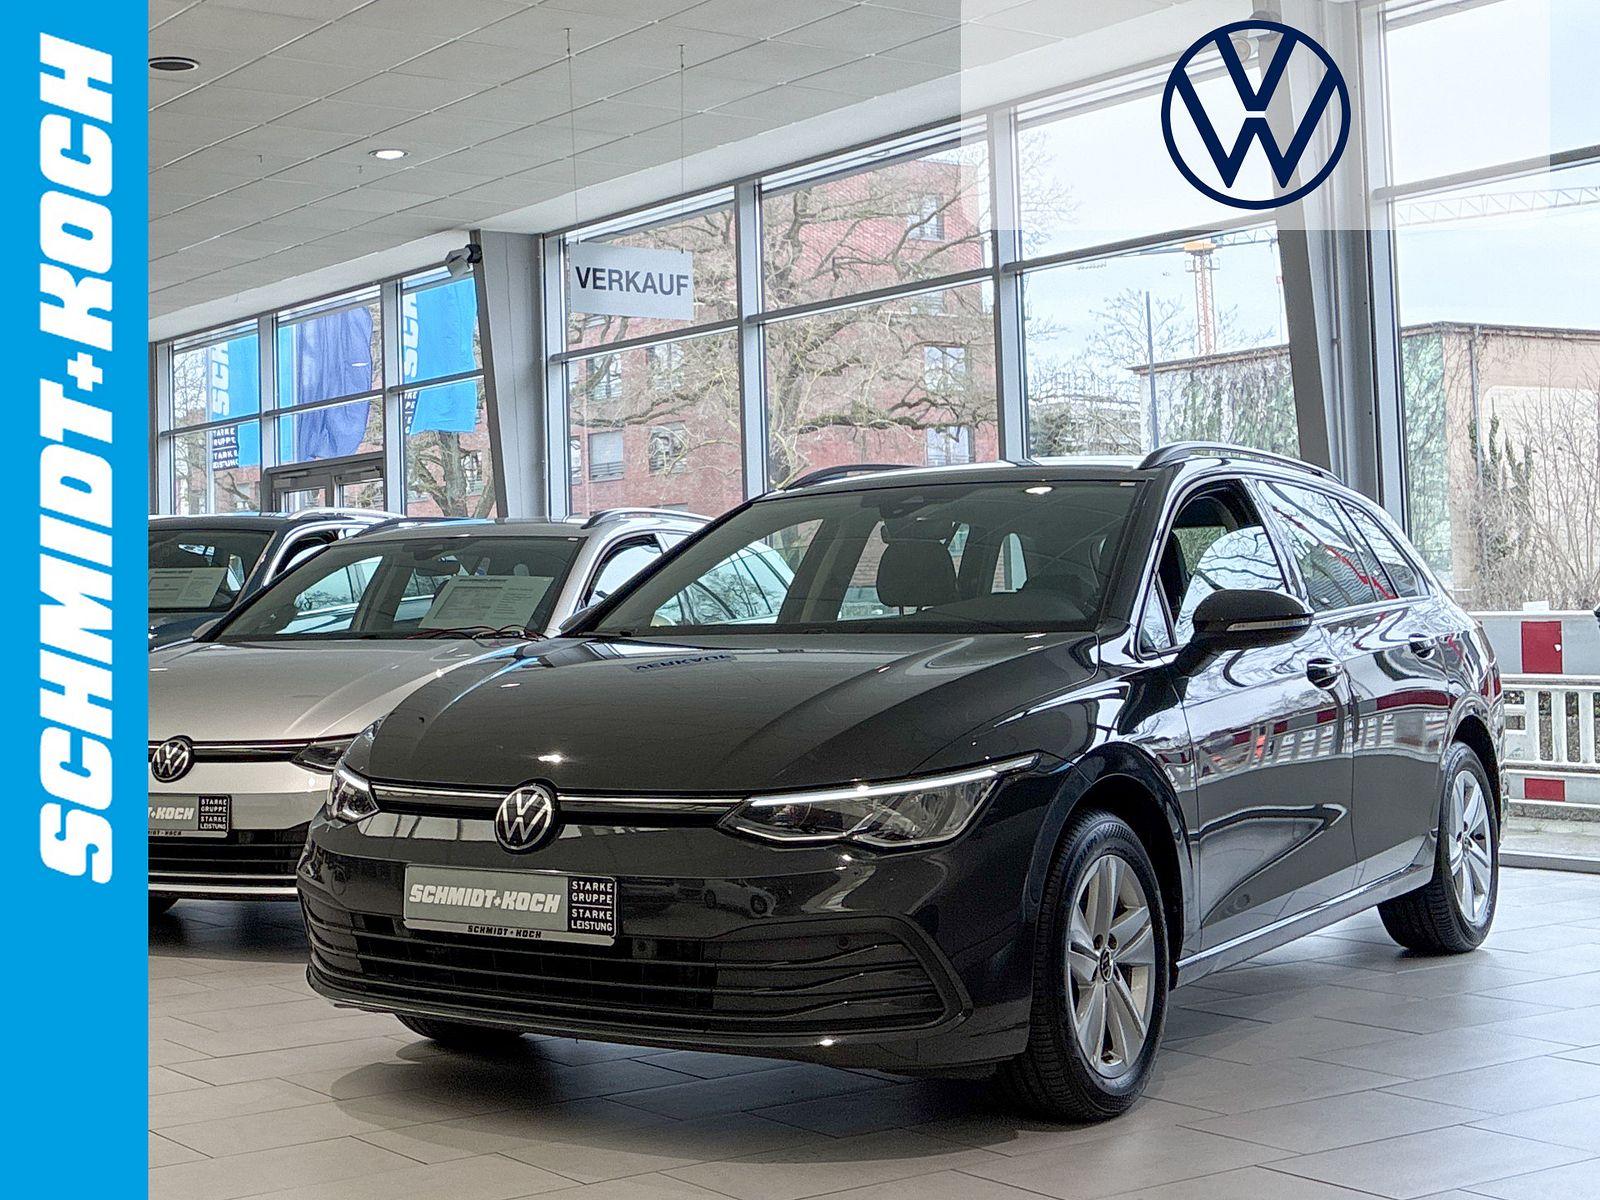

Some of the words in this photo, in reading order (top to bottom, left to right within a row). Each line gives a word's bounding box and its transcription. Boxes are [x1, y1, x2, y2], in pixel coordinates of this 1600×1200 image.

[575, 266, 689, 296] VERKAUF
[571, 881, 613, 893] STARKE
[409, 884, 562, 914] SCHMIDT+KOCH
[571, 892, 613, 904] GRUPPE
[571, 908, 613, 920] STARKE
[467, 925, 508, 937] SCHMIDT
[515, 929, 542, 939] KOCH
[571, 920, 613, 932] LEISTUNG
